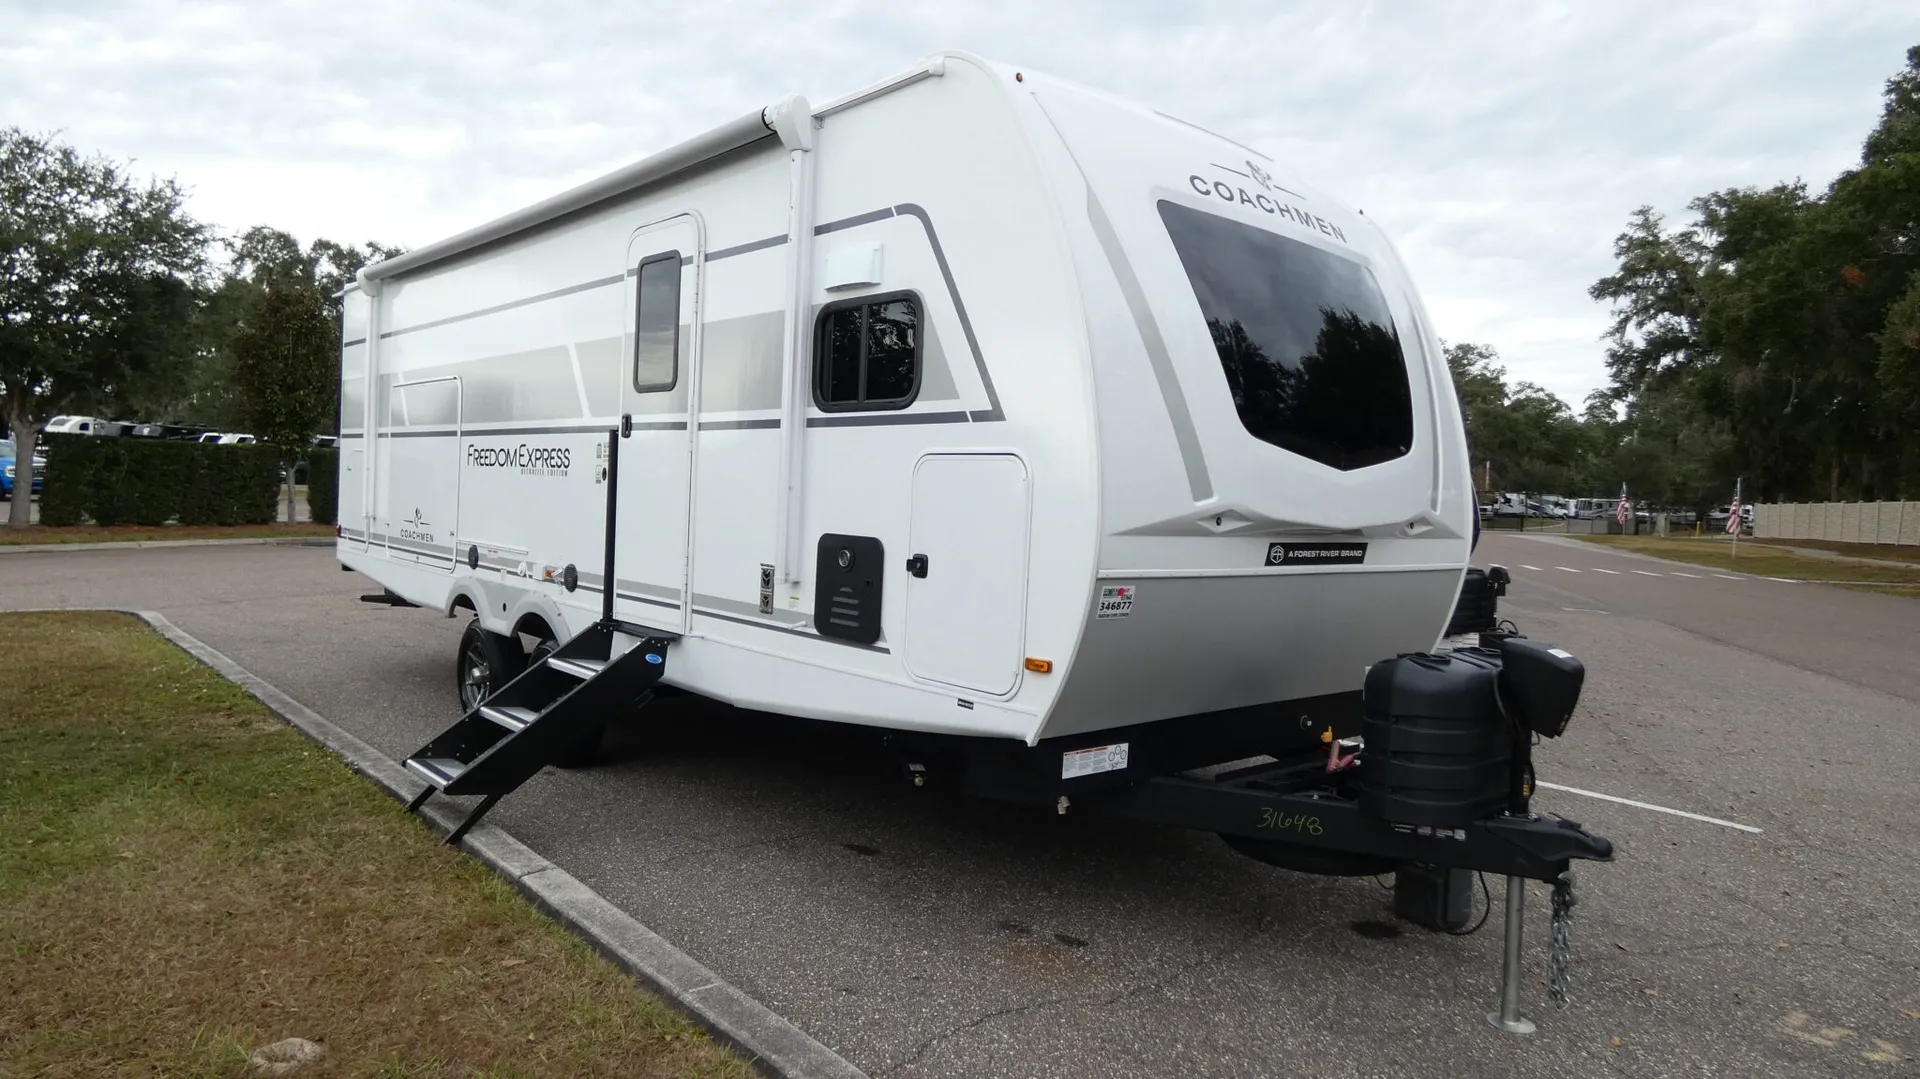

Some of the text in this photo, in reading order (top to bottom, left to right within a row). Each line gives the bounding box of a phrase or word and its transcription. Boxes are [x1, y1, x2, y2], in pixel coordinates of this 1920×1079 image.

[1189, 174, 1348, 244] COACHMEN
[467, 444, 517, 467] FREEDOM
[518, 444, 571, 469] EXPRESS
[400, 528, 434, 543] COACHMEN
[1294, 550, 1319, 558] FOREST
[1099, 601, 1133, 611] 346877
[1256, 807, 1324, 836] 31648
